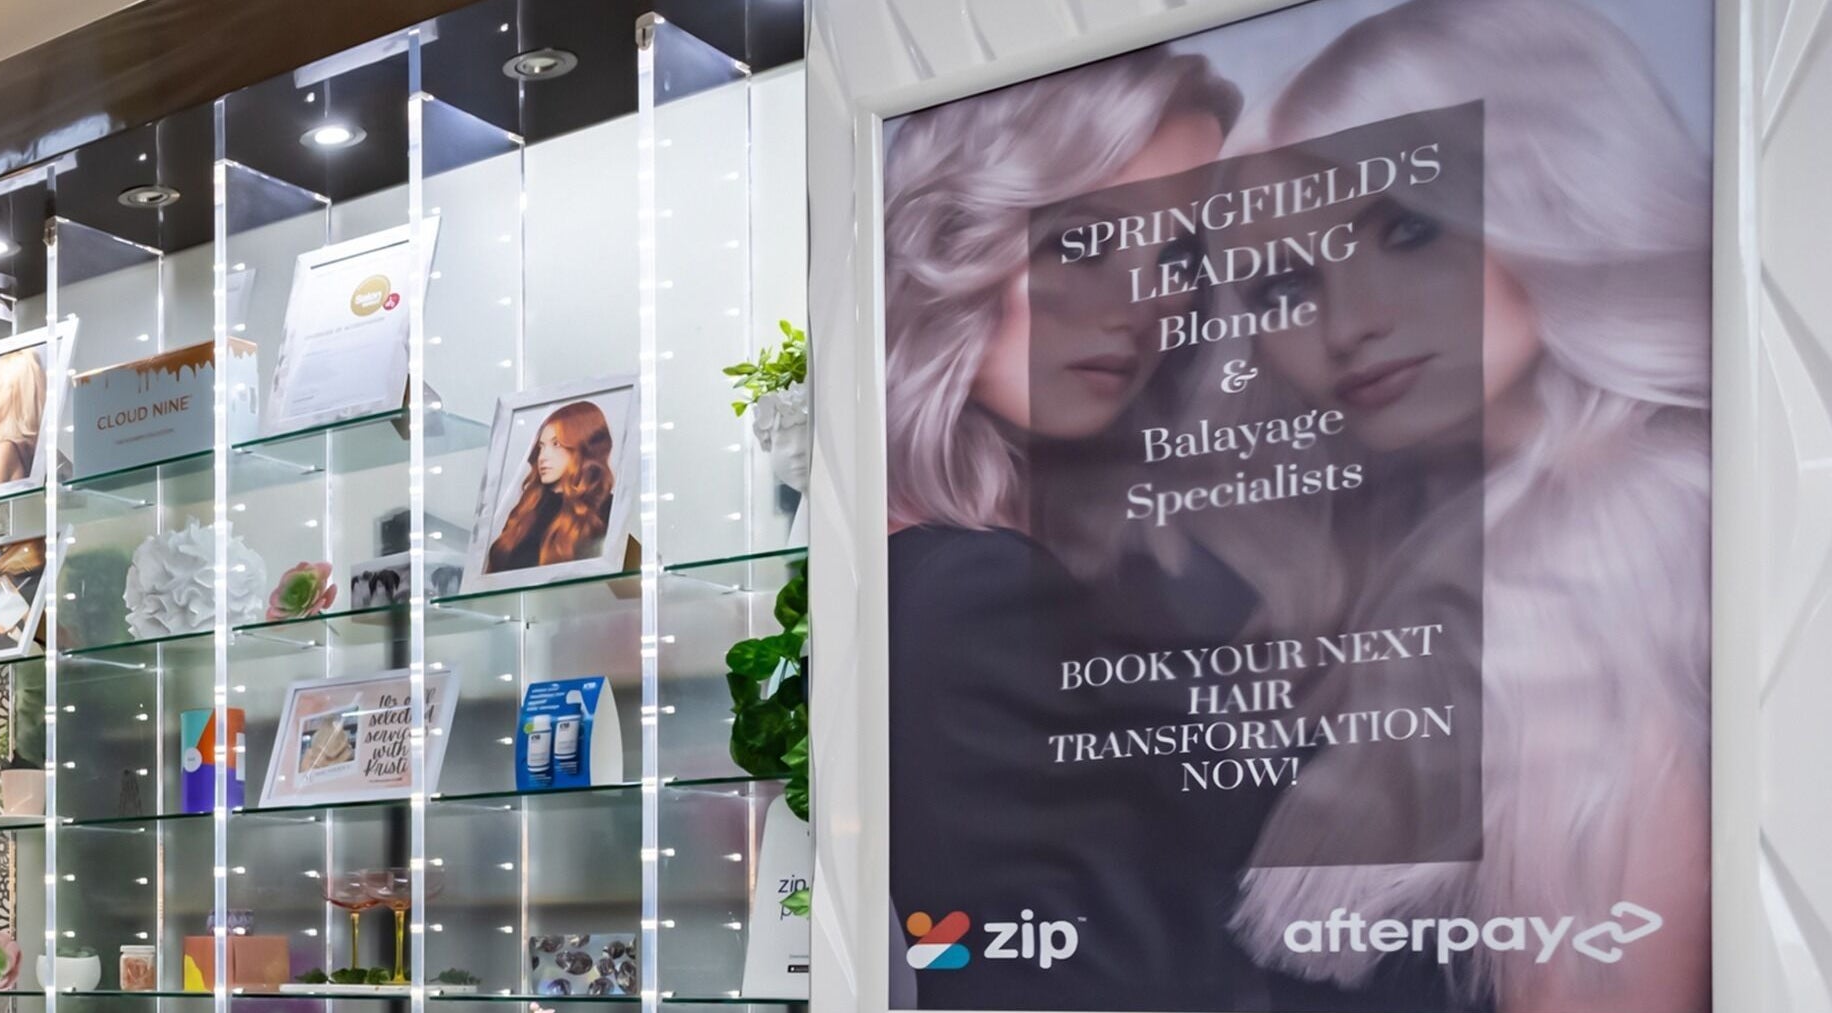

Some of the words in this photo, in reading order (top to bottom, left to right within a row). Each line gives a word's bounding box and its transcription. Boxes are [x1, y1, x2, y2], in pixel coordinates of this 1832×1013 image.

[1060, 143, 1441, 265] SPRINGFIELD'S
[1128, 222, 1359, 303] LEADING
[1158, 296, 1318, 351] Blonde
[1220, 359, 1258, 394] &
[96, 406, 148, 430] CLOUD
[152, 394, 190, 418] NINE
[1141, 408, 1344, 463] Balayage
[1126, 462, 1363, 527] Specialists
[1060, 651, 1177, 690] BOOK
[1182, 638, 1306, 678] YOUR
[1316, 624, 1442, 667] NEXT
[369, 705, 435, 727] selectd
[1187, 679, 1294, 715] HAIR
[373, 740, 408, 760] with
[1048, 705, 1455, 763] TRANSFORMATION
[1181, 757, 1299, 792] NOW!
[983, 909, 1078, 969] zip
[1283, 907, 1572, 964] afterpay
